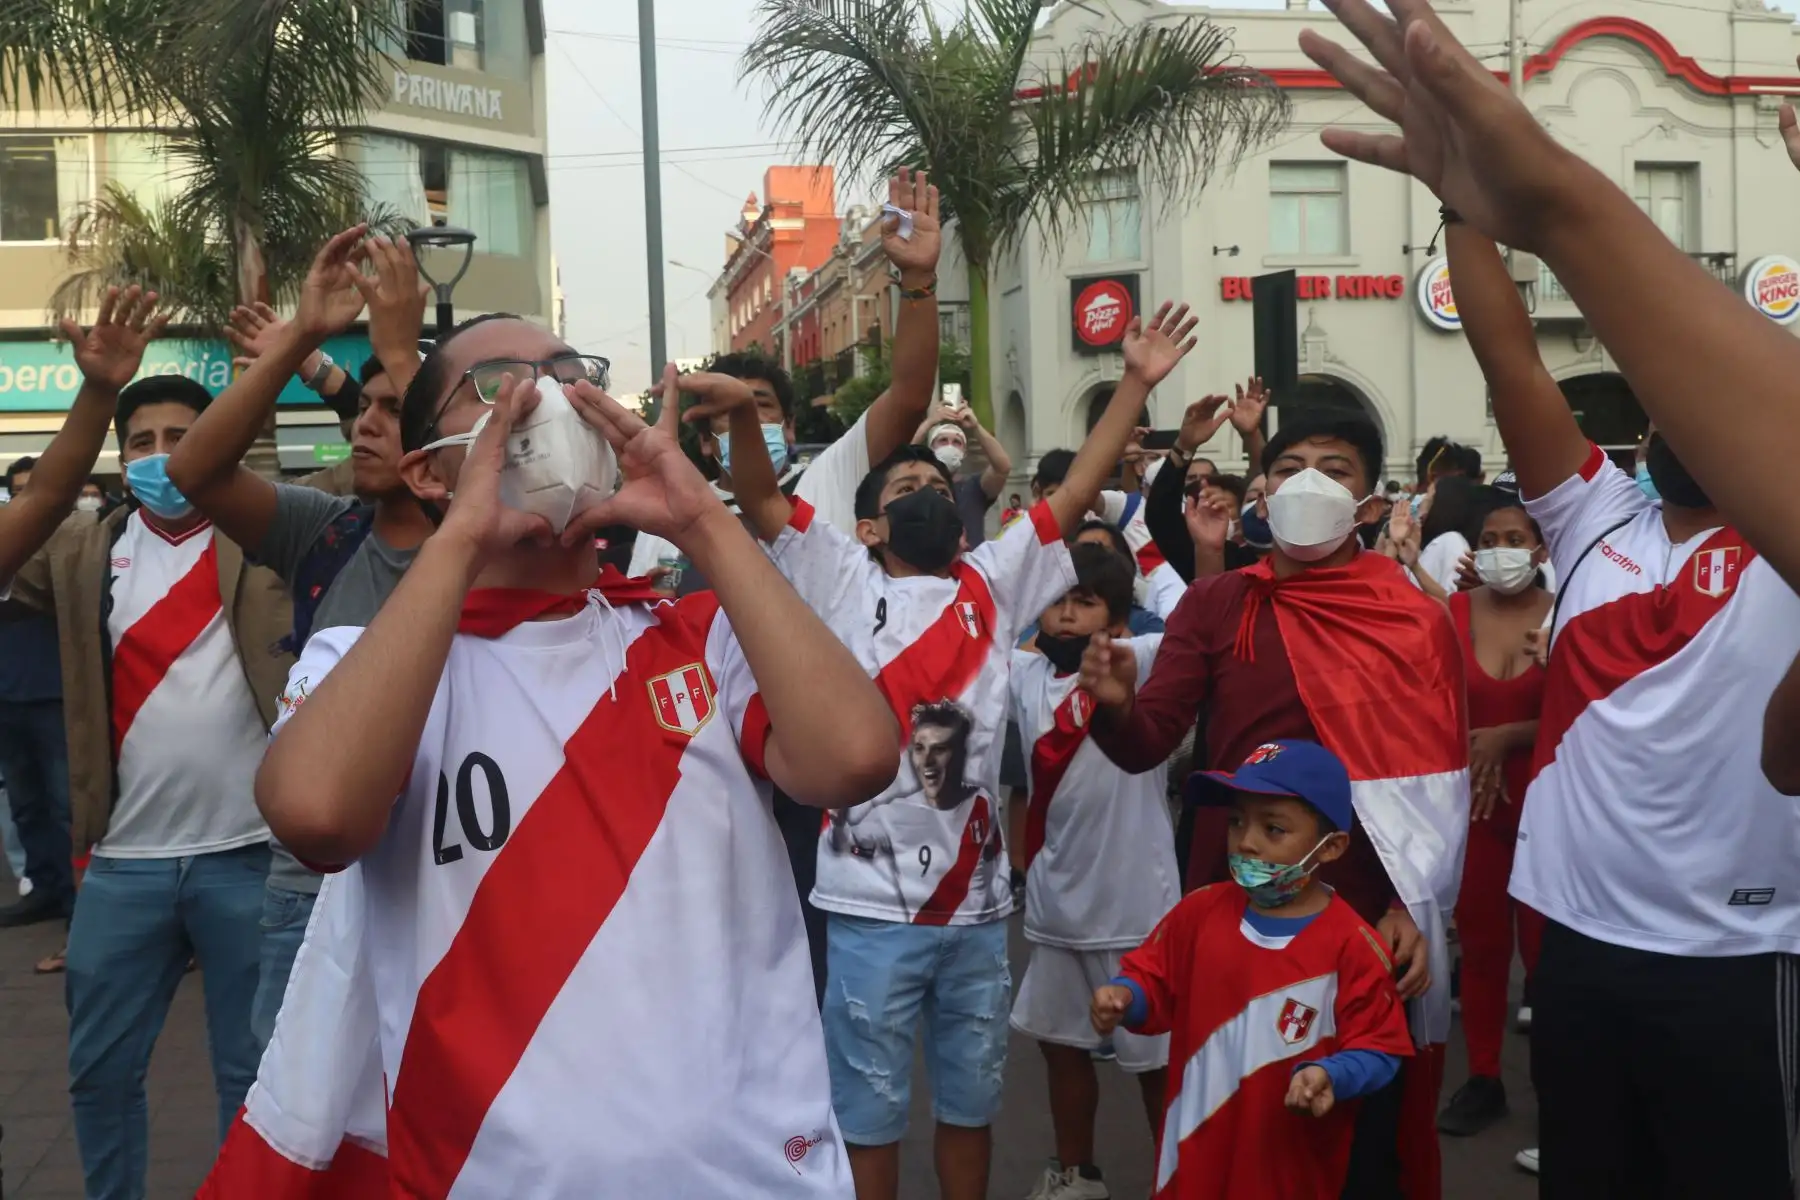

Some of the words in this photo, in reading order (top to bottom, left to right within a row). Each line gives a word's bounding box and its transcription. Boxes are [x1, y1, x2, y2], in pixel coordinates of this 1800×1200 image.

[394, 70, 502, 120] PARIWANA
[1221, 277, 1331, 301] BUER
[1337, 275, 1405, 300] KING
[1760, 283, 1799, 305] KING
[872, 596, 887, 637] 9
[432, 751, 511, 866] 20
[918, 844, 932, 878] 9
